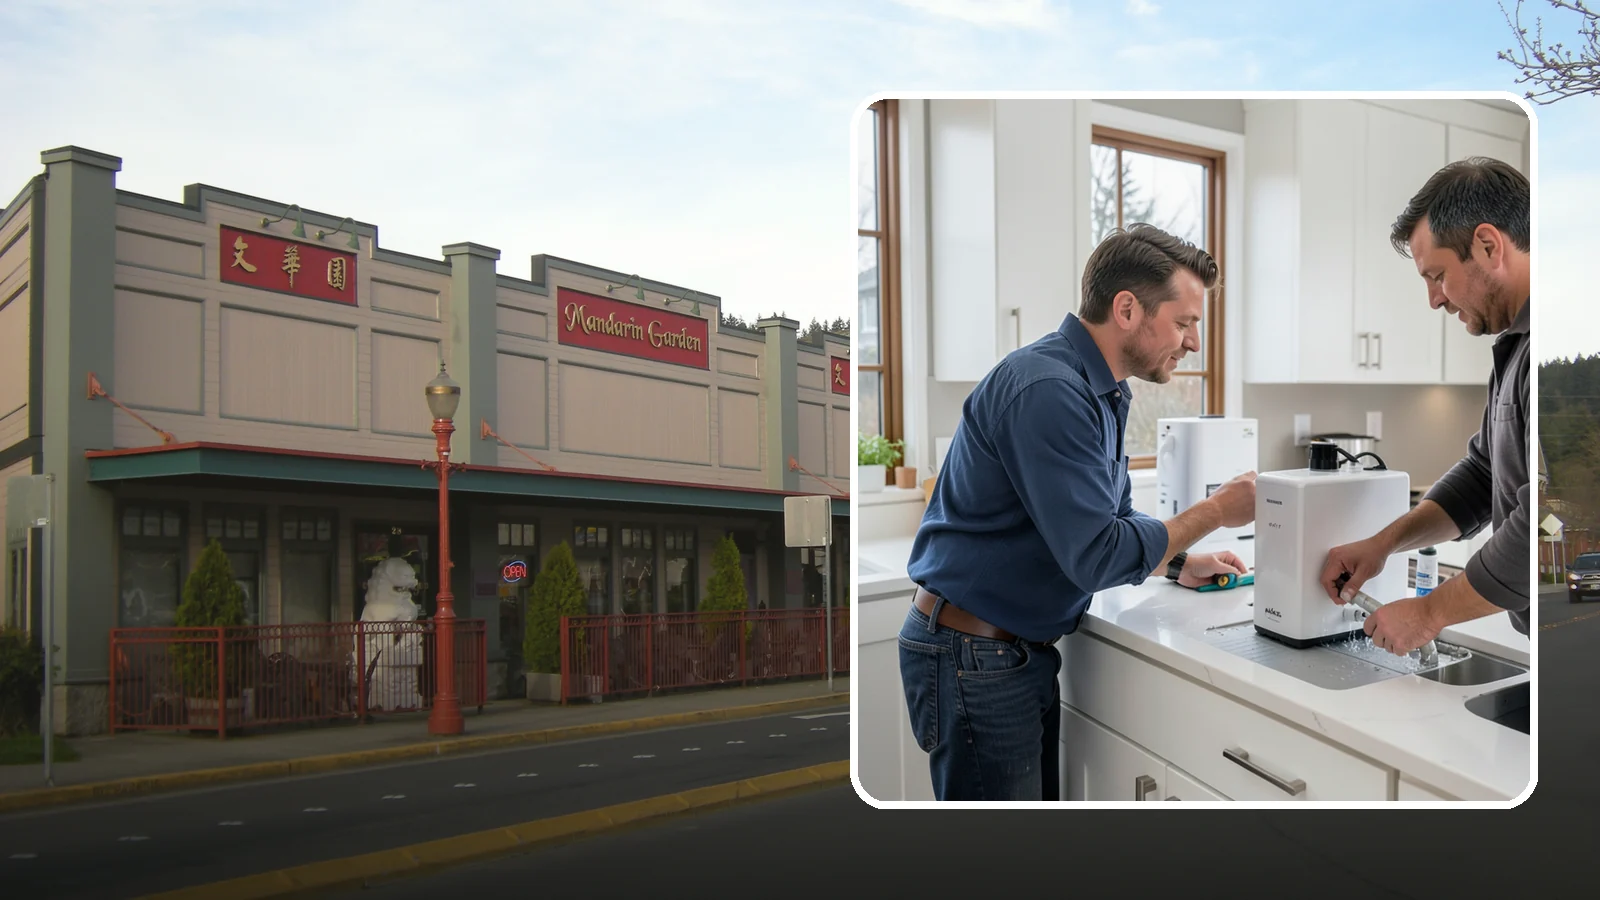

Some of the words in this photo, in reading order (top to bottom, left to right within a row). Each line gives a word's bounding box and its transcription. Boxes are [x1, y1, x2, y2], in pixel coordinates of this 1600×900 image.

[231, 236, 346, 290] 文華園
[564, 302, 644, 341] Mandarin
[648, 320, 701, 352] Garden
[503, 565, 527, 578] OPEN
